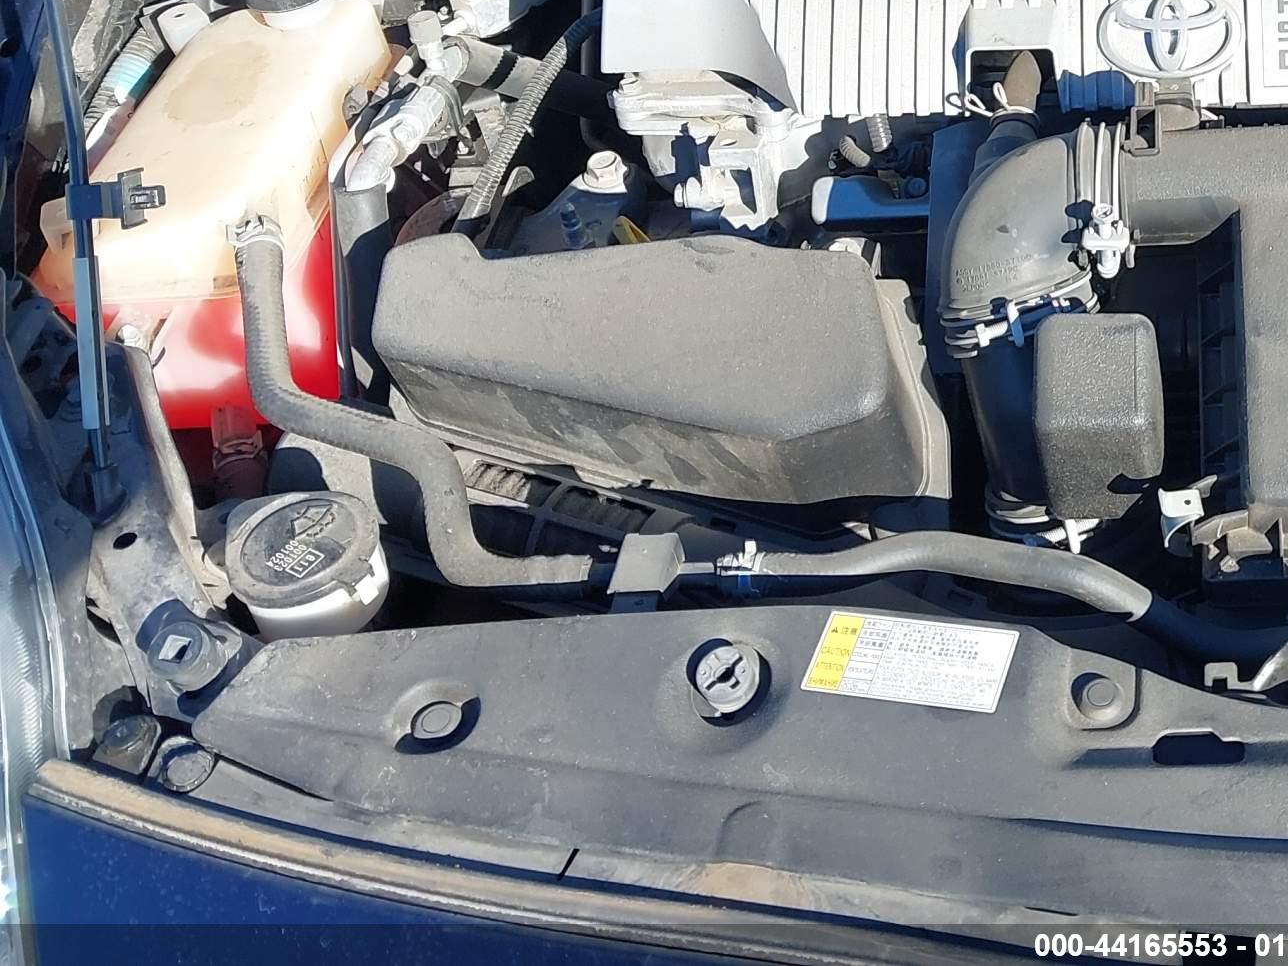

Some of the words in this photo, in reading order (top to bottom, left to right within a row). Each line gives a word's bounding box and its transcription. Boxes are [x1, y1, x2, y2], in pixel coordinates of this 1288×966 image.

[265, 539, 299, 568] 001024
[273, 544, 307, 572] 001023
[820, 646, 851, 657] CAUTION
